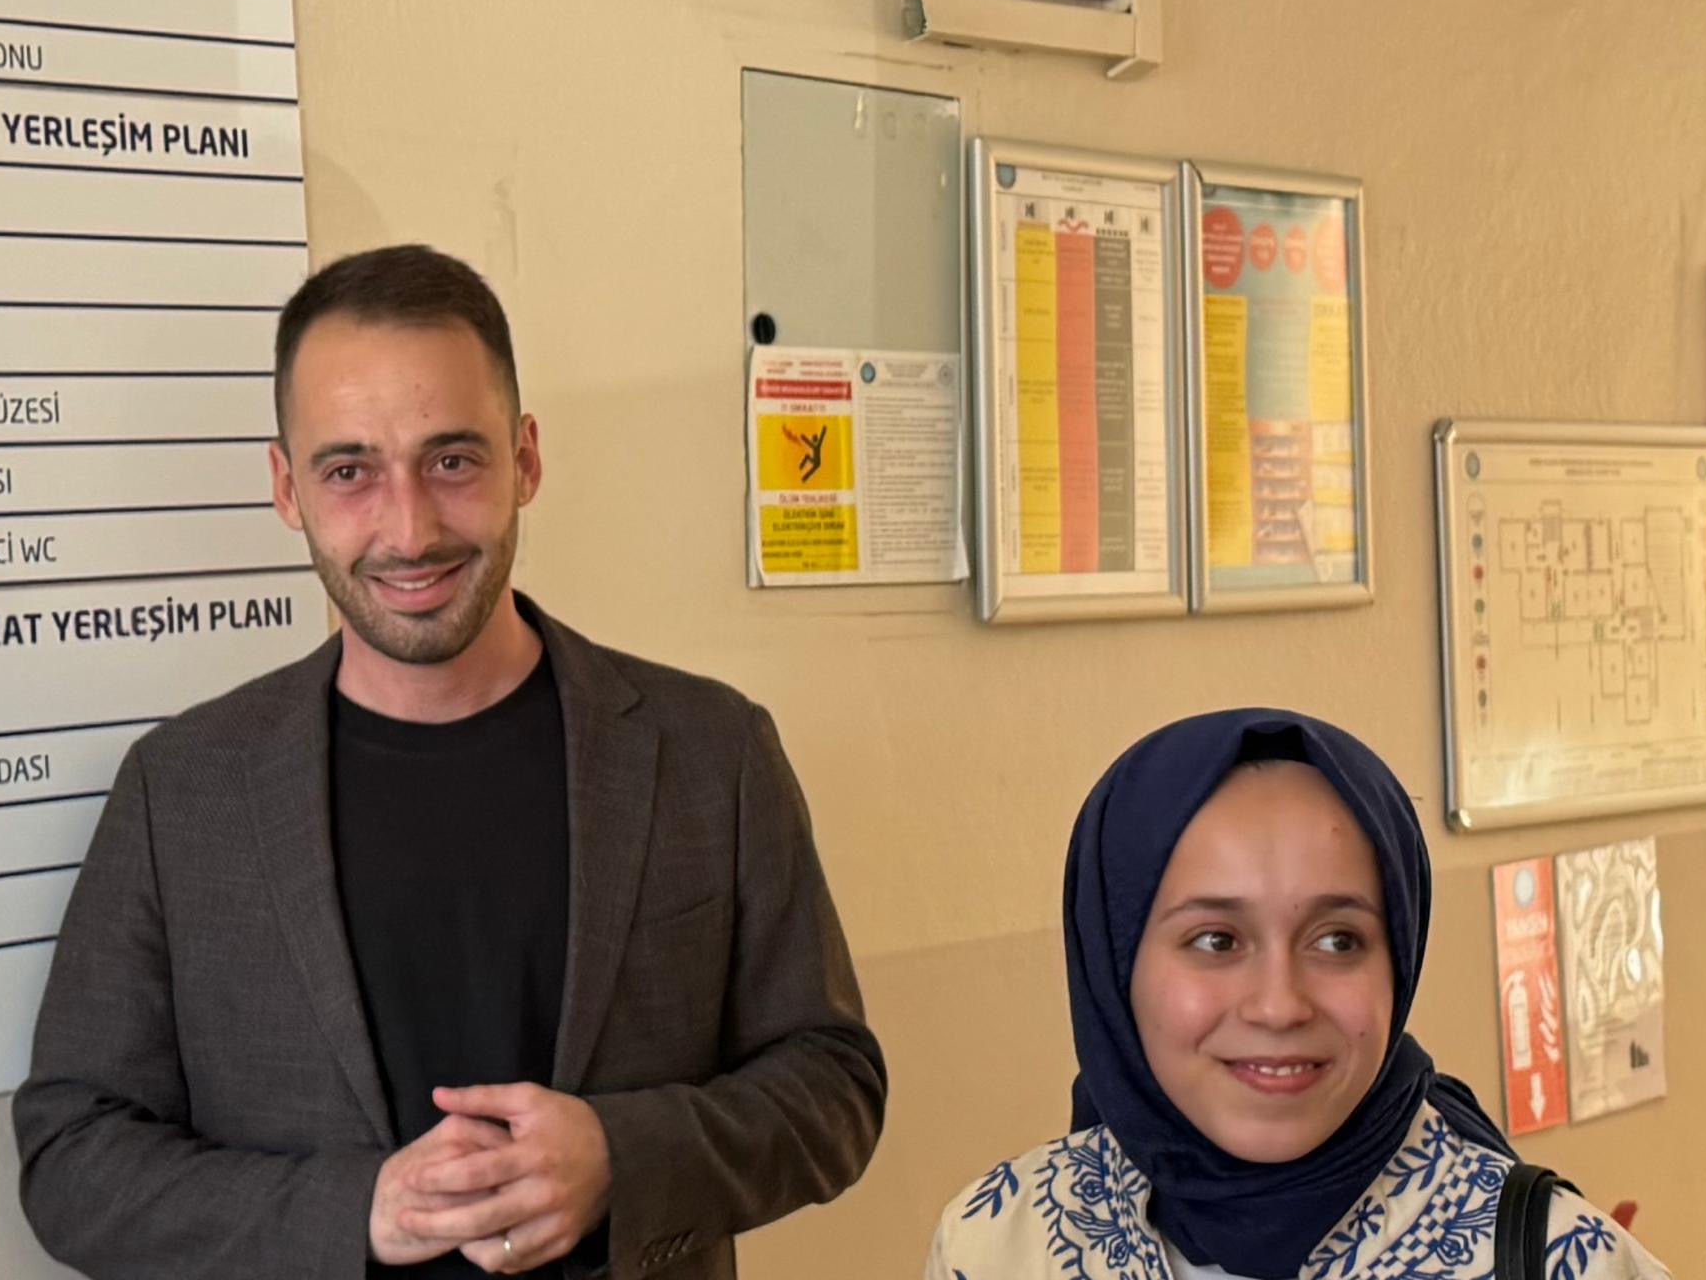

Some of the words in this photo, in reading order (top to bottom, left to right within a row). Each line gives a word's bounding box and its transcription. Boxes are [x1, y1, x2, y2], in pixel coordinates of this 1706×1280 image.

[2, 113, 152, 156] YERLEŞİM
[163, 124, 248, 158] PLANI
[20, 536, 56, 562] WC
[52, 597, 199, 642] YERLEŞİM
[210, 597, 292, 631] PLANI
